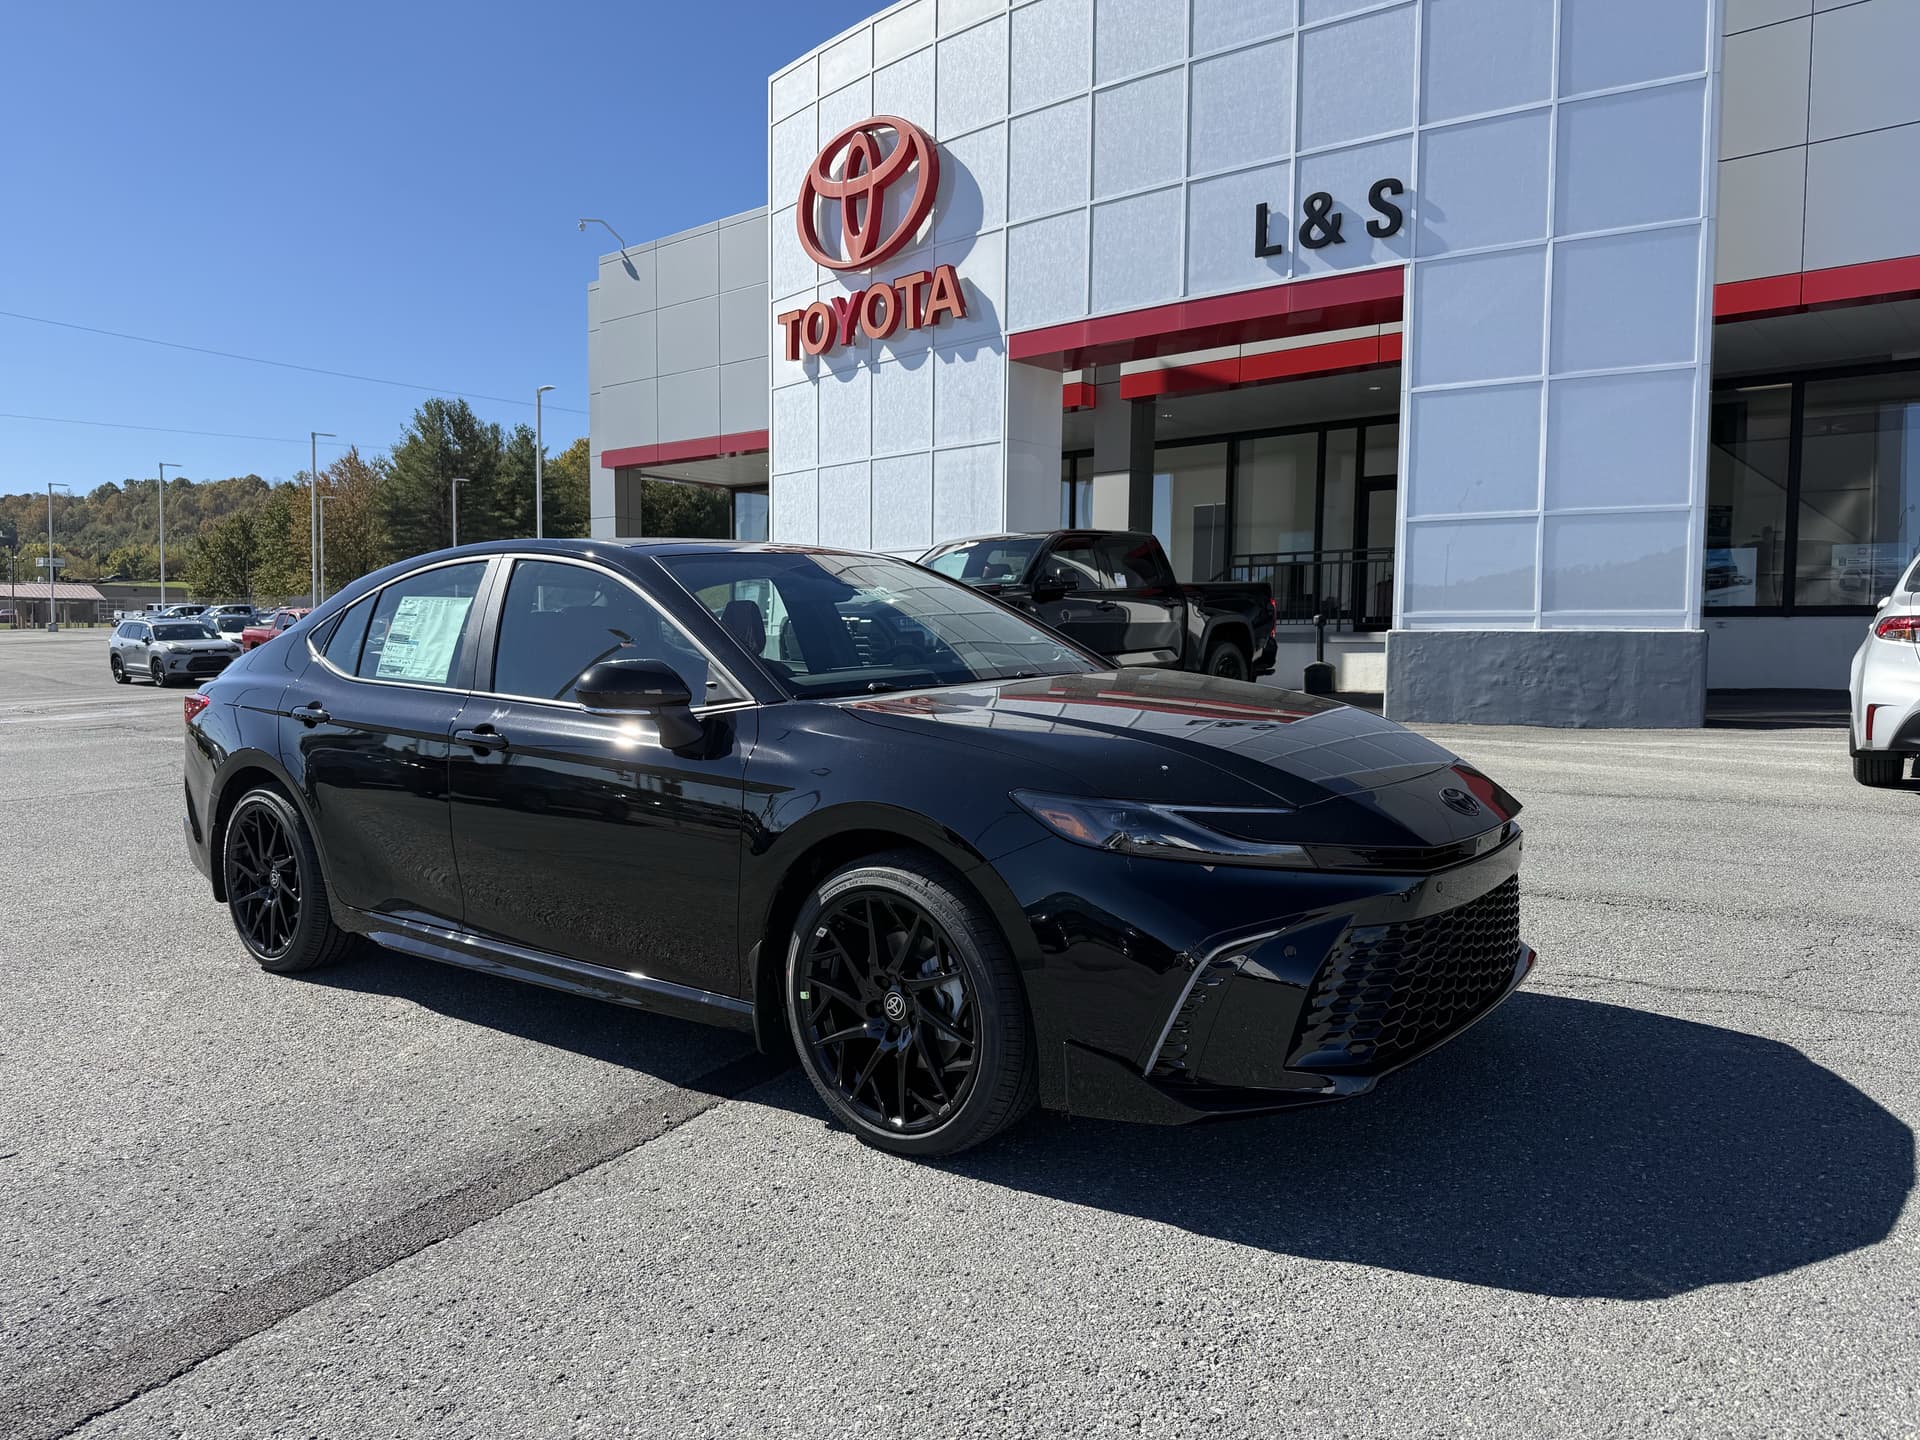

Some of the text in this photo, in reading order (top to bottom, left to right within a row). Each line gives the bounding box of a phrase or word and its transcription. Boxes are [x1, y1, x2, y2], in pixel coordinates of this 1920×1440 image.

[1255, 178, 1404, 258] L & S
[778, 264, 966, 361] TOYOTA
